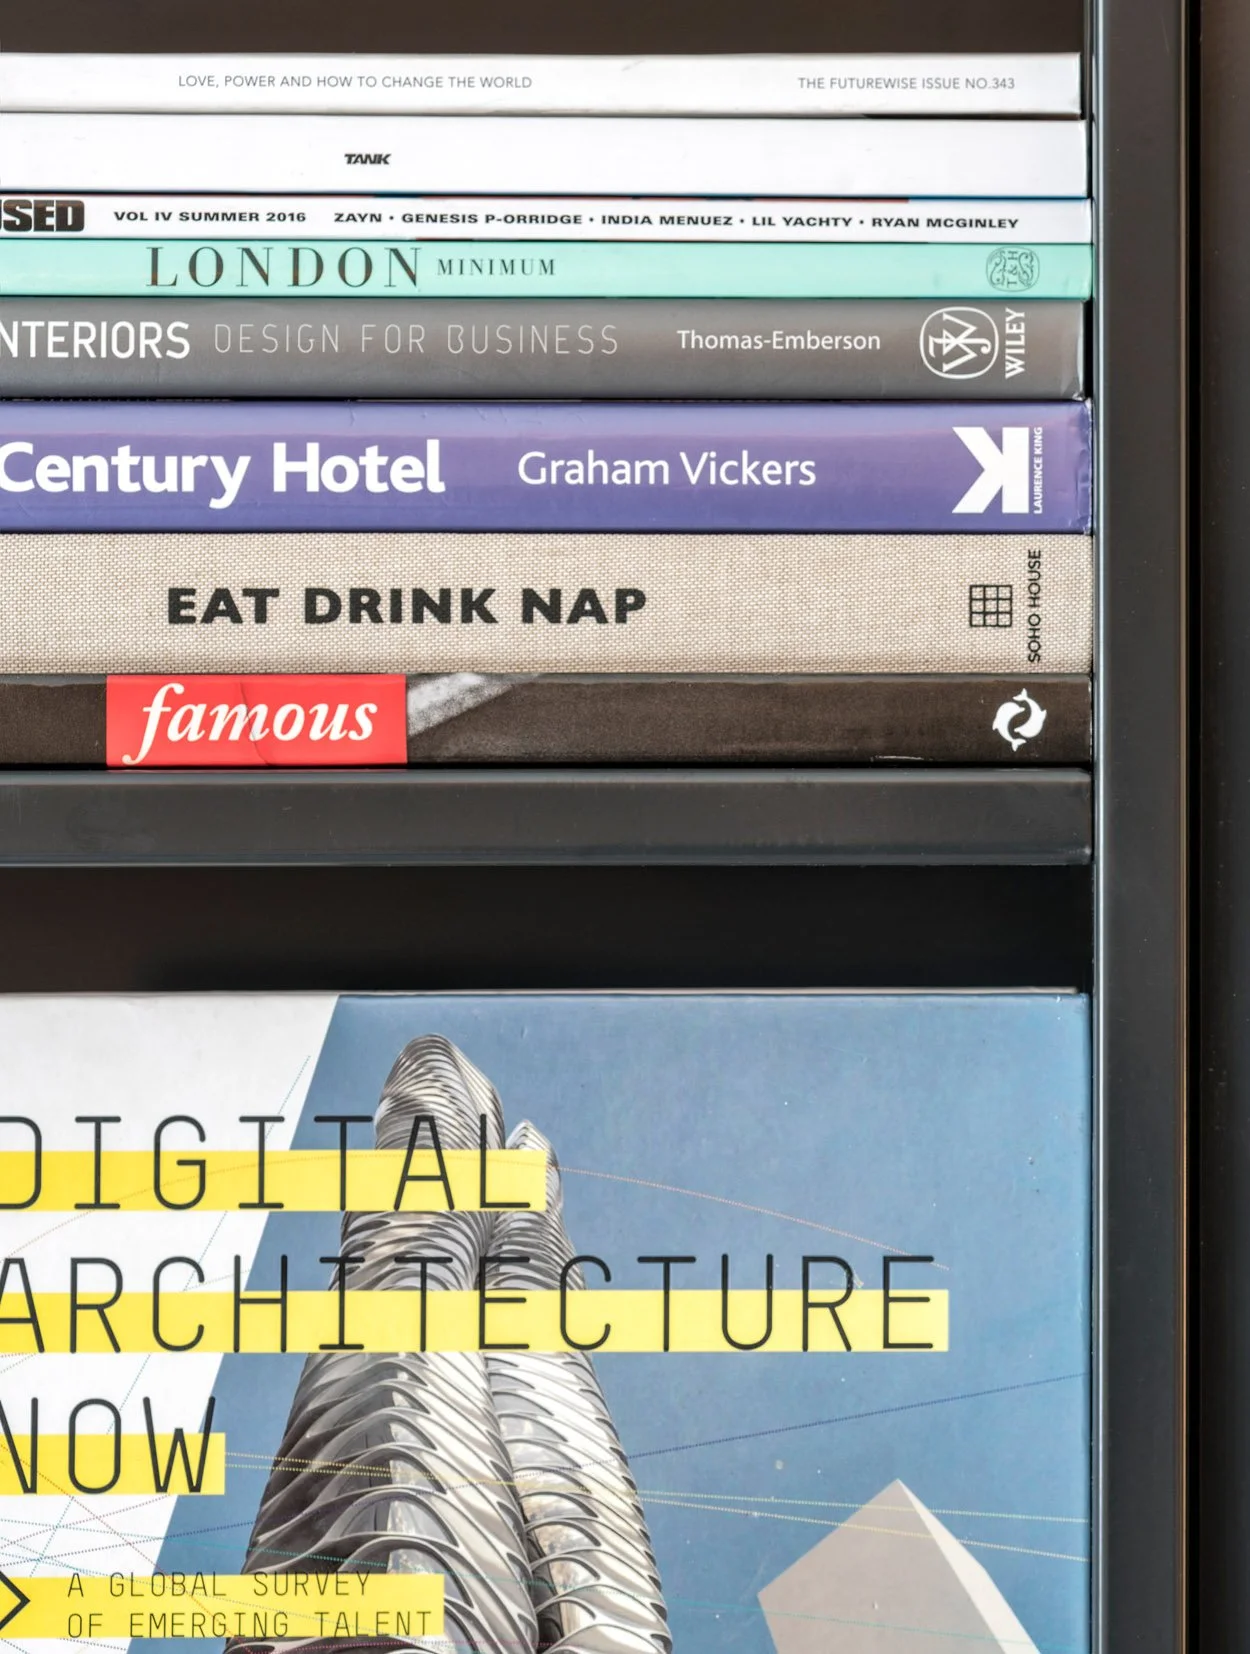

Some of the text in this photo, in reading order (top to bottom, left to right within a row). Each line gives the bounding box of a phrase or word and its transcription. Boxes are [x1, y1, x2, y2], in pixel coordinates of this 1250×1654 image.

[178, 74, 533, 90] LOVE, POWER AND HOW TO CHANGE THE WORLD
[797, 77, 1016, 91] THE FUTUREWISE ISSUE NO.343
[344, 153, 392, 165] TANK
[0, 199, 85, 232] SED
[113, 210, 1020, 230] VOL IV SUMMER 2016 ZAYN GENESIS P-ORRIDGE INDIA MENUEZ LIL YACHTY RYAN MCGINLEY
[146, 246, 555, 288] LONDON MINIMUM
[213, 323, 340, 355] DESIGN
[360, 323, 426, 355] FOR
[447, 323, 619, 356] BUSINESS
[676, 329, 882, 351] Thomas-Emberson
[1005, 307, 1026, 379] WILEY
[0, 438, 446, 509] Century Hotel
[517, 449, 818, 486] Graham Vickers
[1033, 427, 1043, 514] LAURENCE KING
[168, 587, 647, 625] EAT DRINK NAP
[1028, 549, 1042, 663] SOHO HOUSE
[122, 682, 378, 764] famous
[0, 1114, 532, 1210] DIGITAL
[0, 1254, 936, 1353] ARCHITECTURE
[0, 1396, 216, 1494] NOW
[67, 1571, 371, 1598] A GLOBAL SURVEY
[67, 1610, 432, 1638] OF EMERGING TALENT
